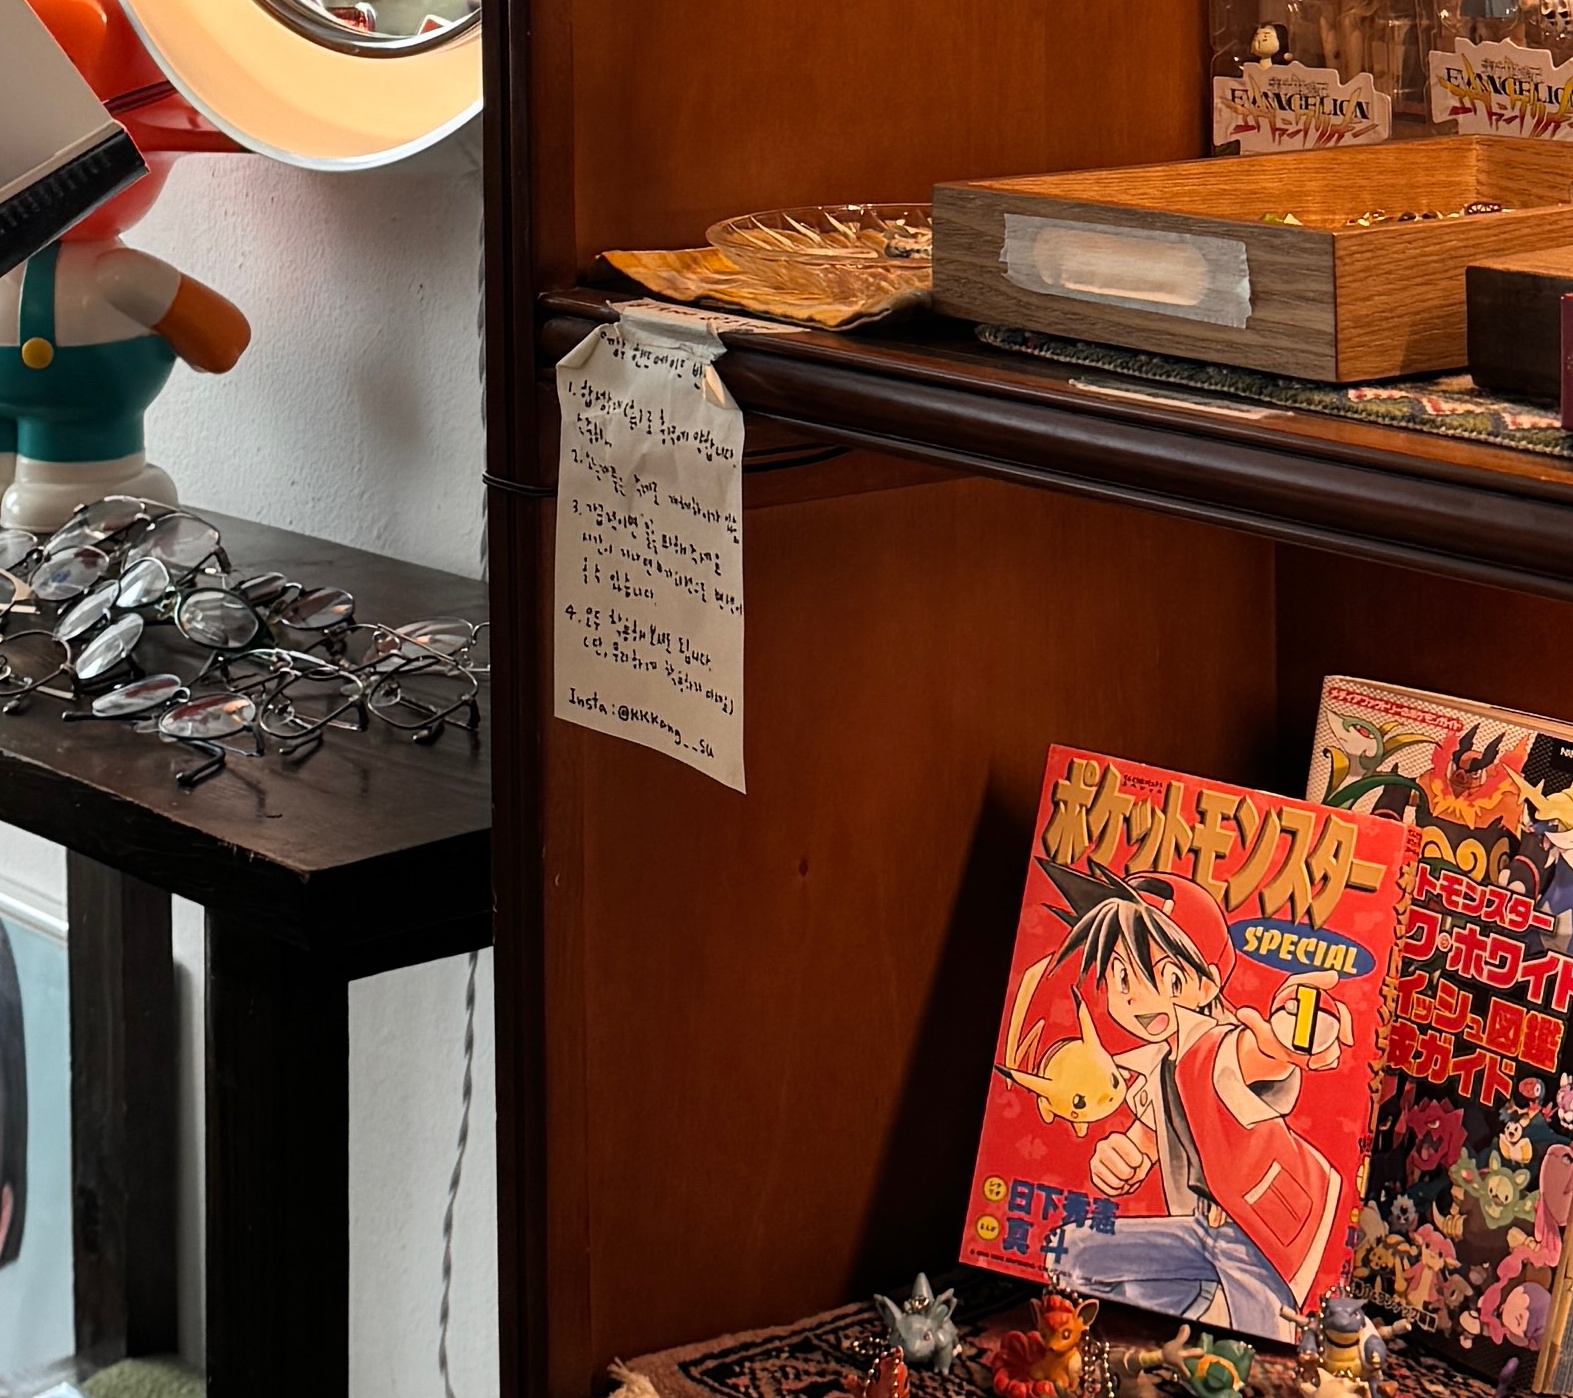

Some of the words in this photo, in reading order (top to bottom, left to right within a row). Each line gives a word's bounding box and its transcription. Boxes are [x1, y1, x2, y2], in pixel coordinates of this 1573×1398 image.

[1229, 87, 1371, 121] EVANGELION
[1042, 757, 1386, 930] ポケットモンスター
[1243, 925, 1358, 975] SPECIAL
[1290, 985, 1321, 1057] 1
